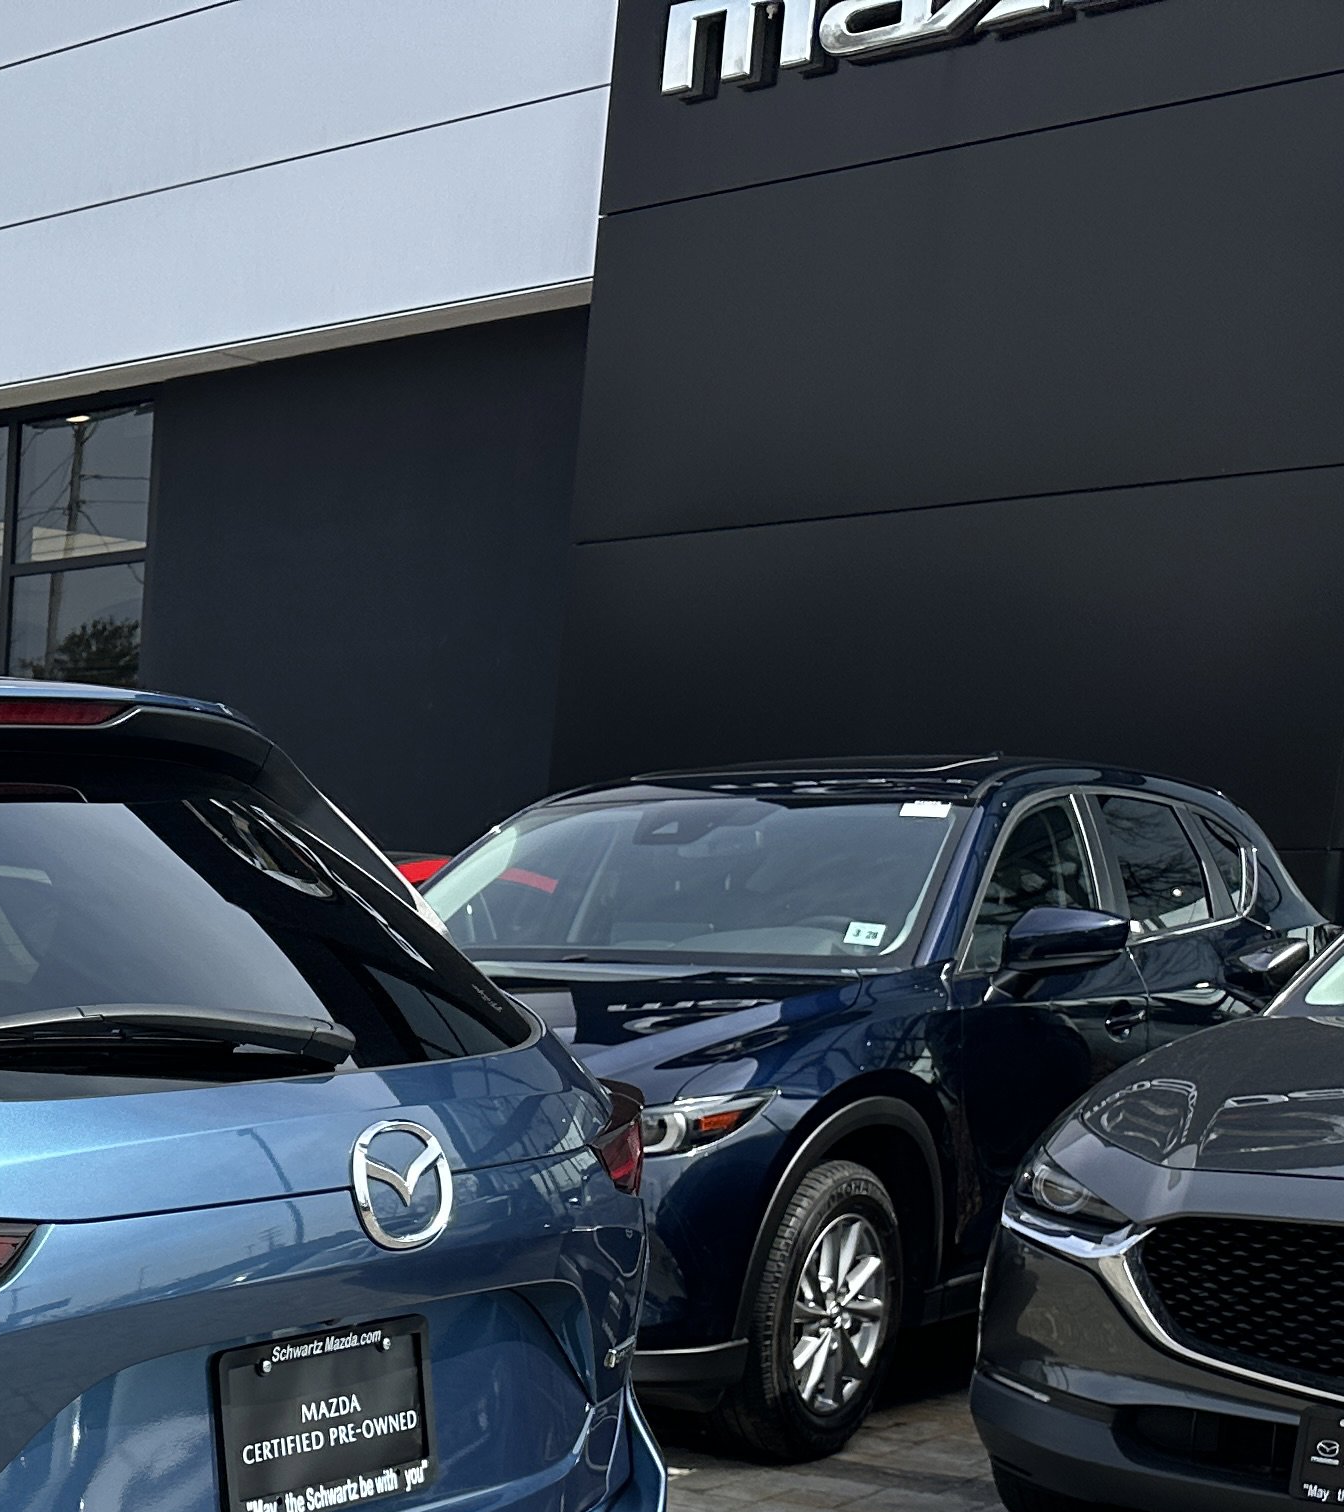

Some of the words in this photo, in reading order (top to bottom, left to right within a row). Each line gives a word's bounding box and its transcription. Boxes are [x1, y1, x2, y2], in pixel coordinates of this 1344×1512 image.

[661, 0, 1162, 95] ma
[301, 1393, 361, 1423] MAZDA
[242, 1430, 325, 1465] CERTIFIED
[329, 1409, 418, 1447] PRE-OWNED
[306, 1479, 359, 1511] Schwartz
[359, 1474, 374, 1498] be
[374, 1467, 398, 1492] with
